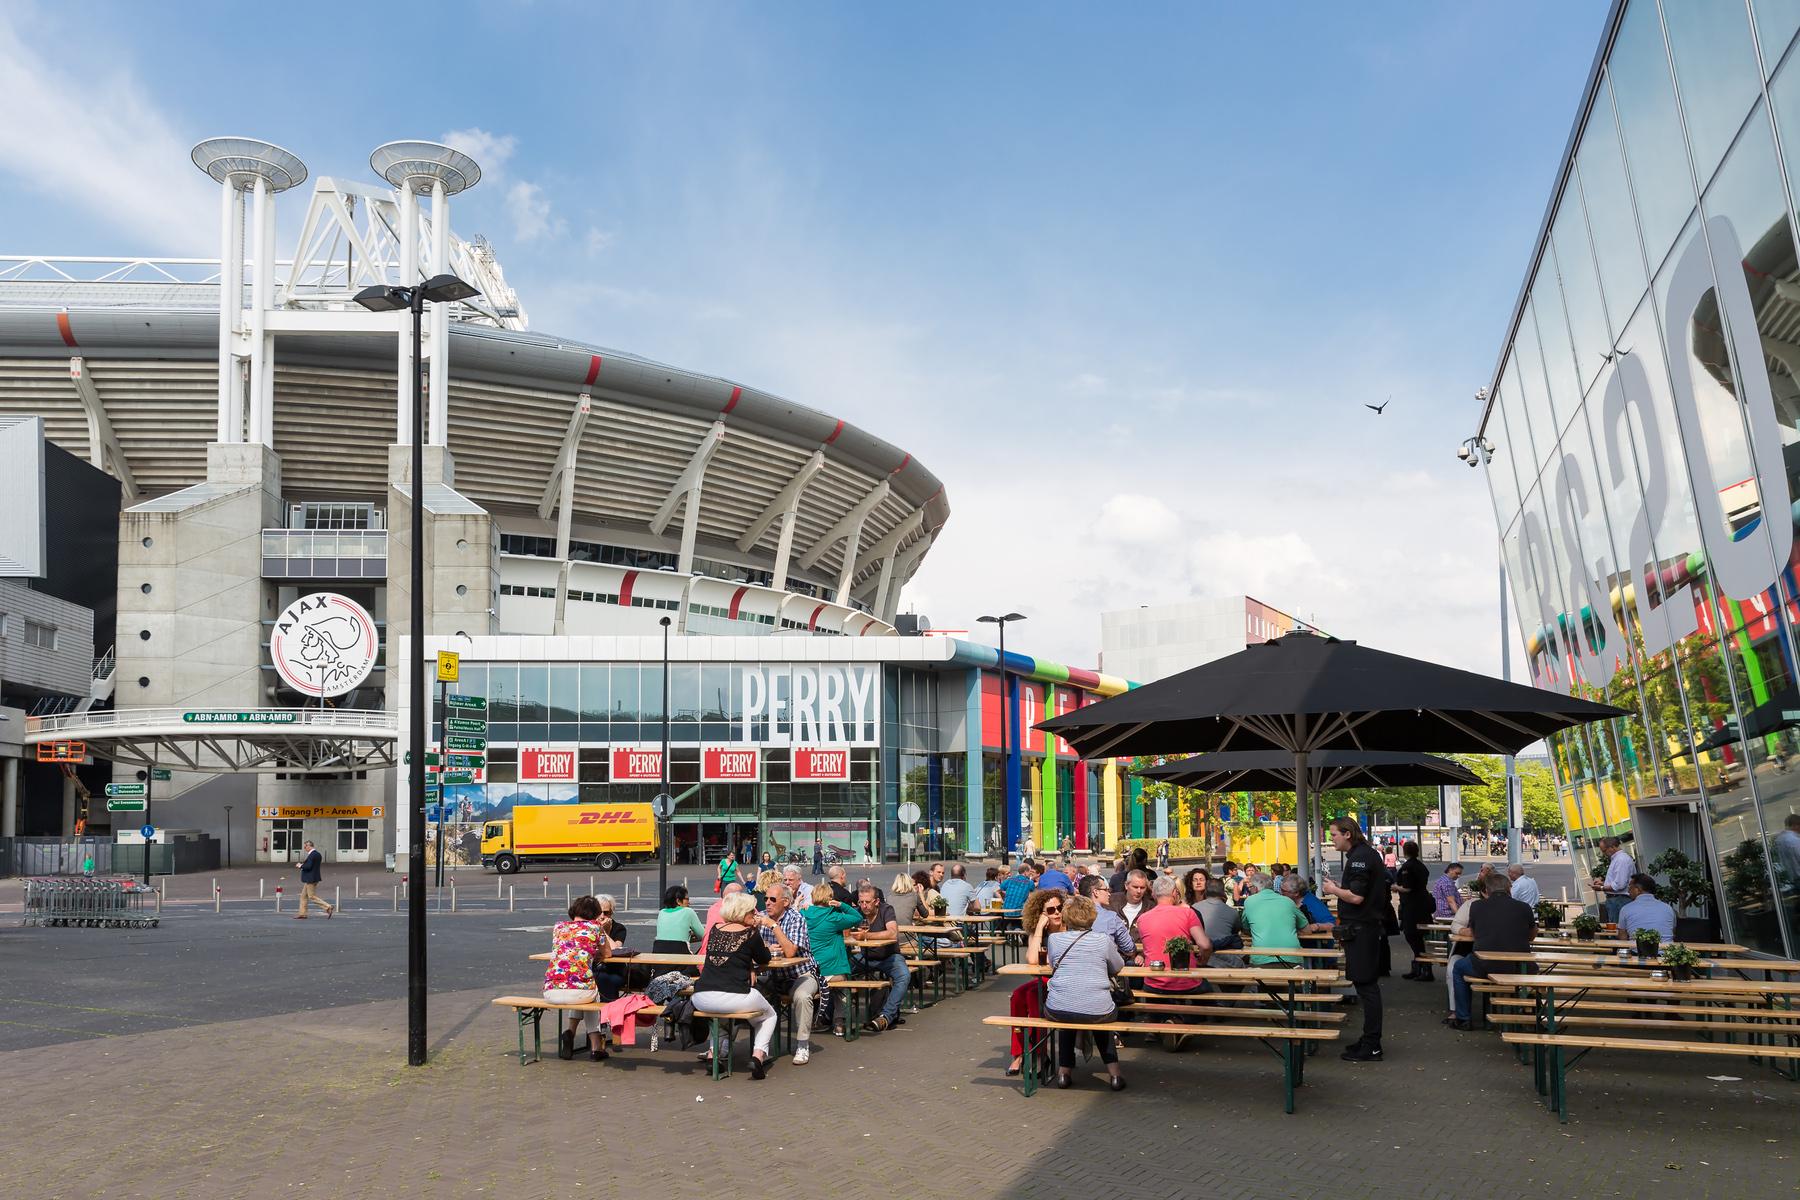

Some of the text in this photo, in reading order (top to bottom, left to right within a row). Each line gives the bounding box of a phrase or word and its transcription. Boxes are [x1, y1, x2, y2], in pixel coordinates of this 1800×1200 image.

[278, 595, 328, 636] AJAX
[326, 659, 370, 692] AMSTERDAM
[742, 665, 874, 742] PERRY
[537, 754, 571, 773] PERRY
[629, 754, 662, 773] PERRY
[720, 753, 753, 773] PERRY
[811, 753, 843, 772] PERRY
[282, 807, 311, 817] Ingang
[314, 807, 324, 815] P1
[332, 807, 358, 815] ArenA
[578, 811, 637, 825] DHL
